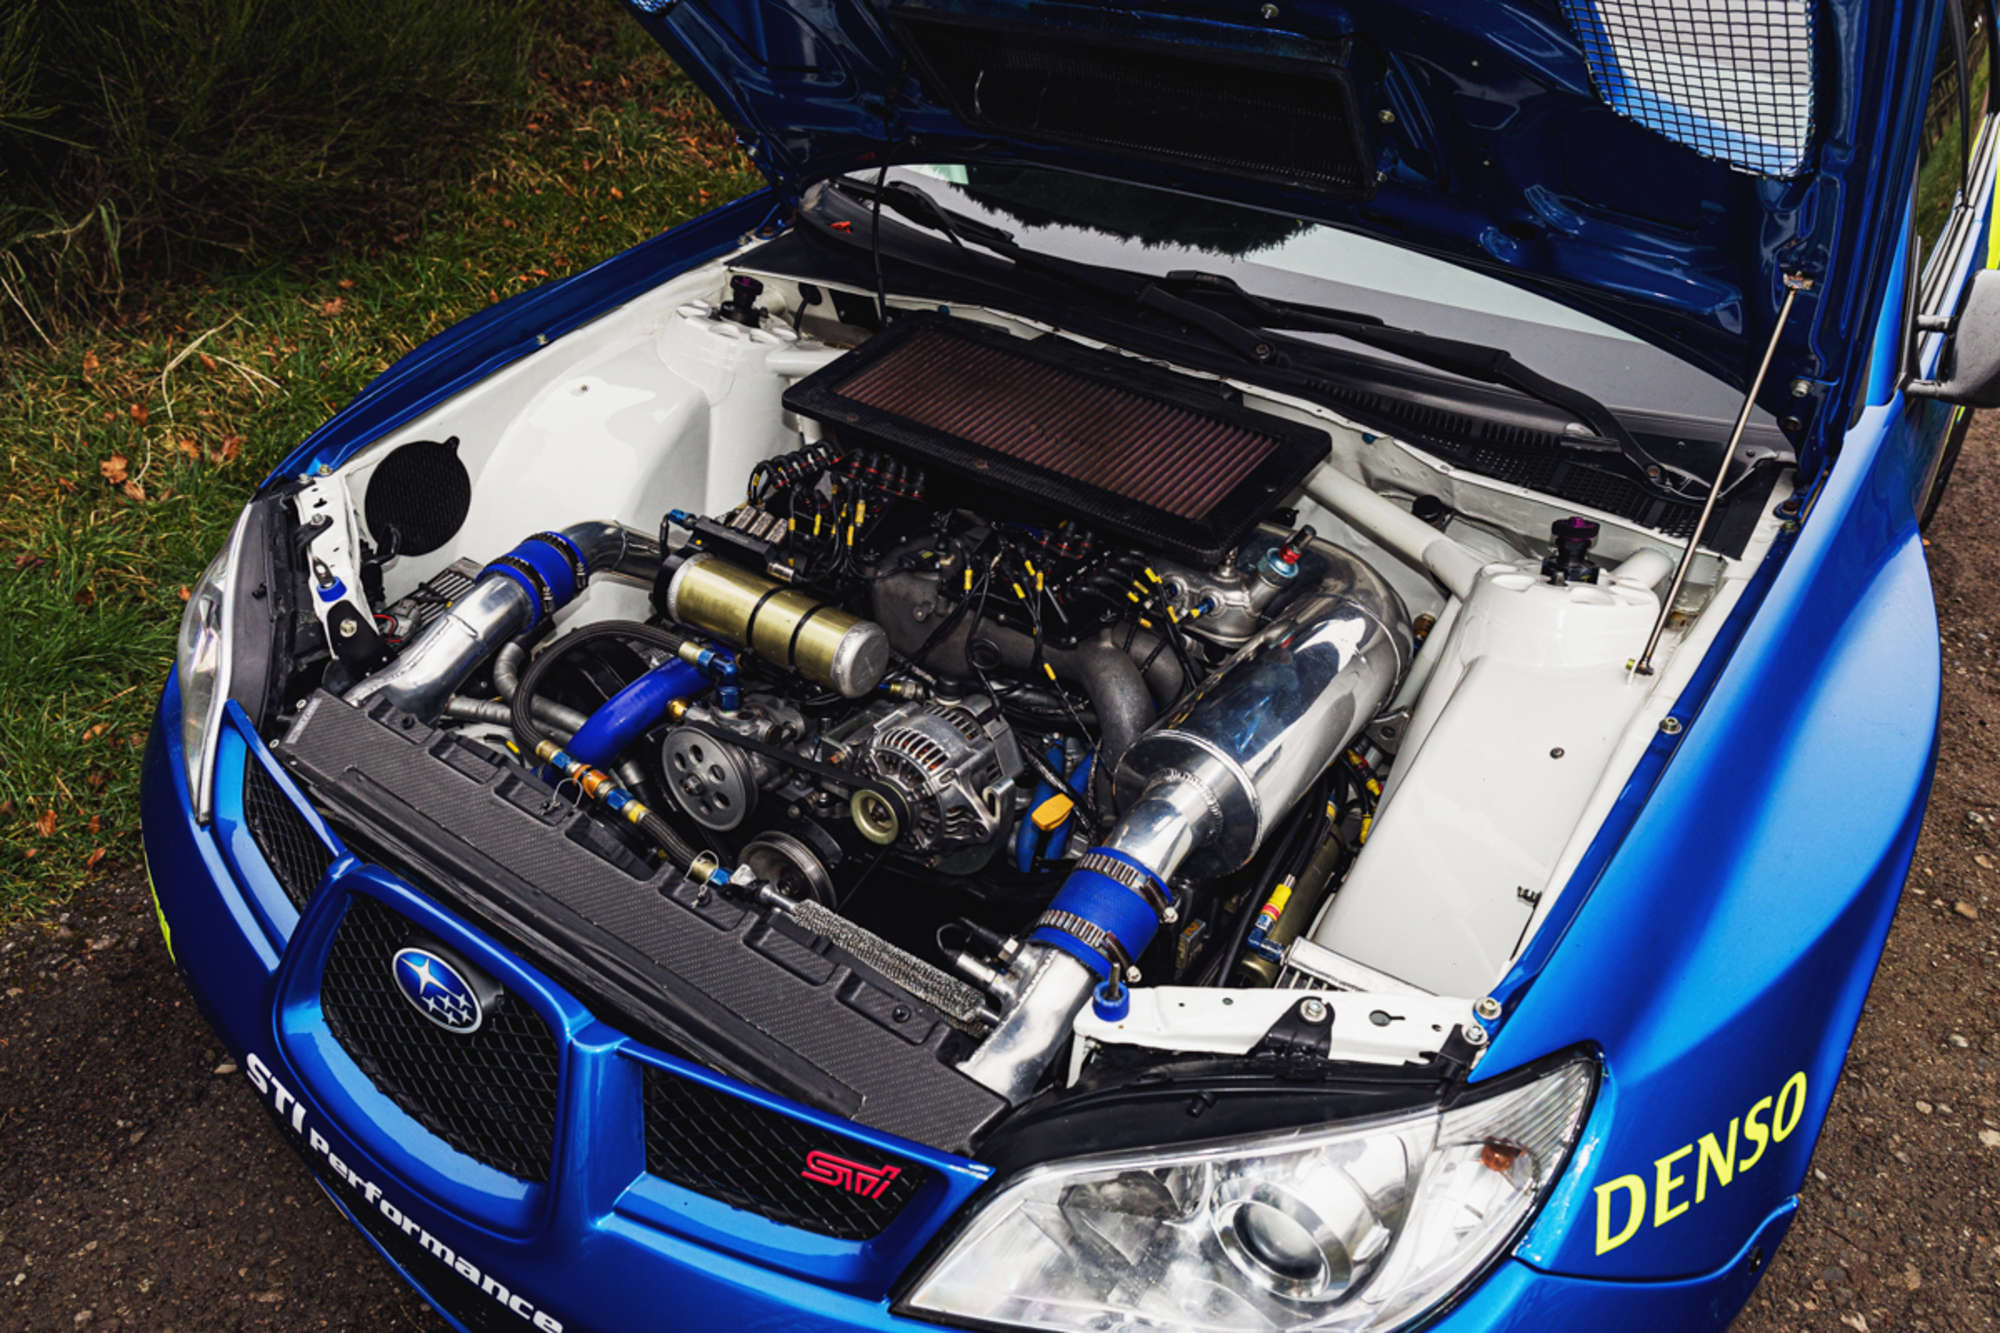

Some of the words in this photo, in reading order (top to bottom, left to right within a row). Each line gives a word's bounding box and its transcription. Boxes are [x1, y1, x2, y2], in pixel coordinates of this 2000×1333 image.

[246, 1052, 307, 1135] STI
[309, 1126, 564, 1333] Performance
[1593, 1070, 1807, 1257] DENSO
